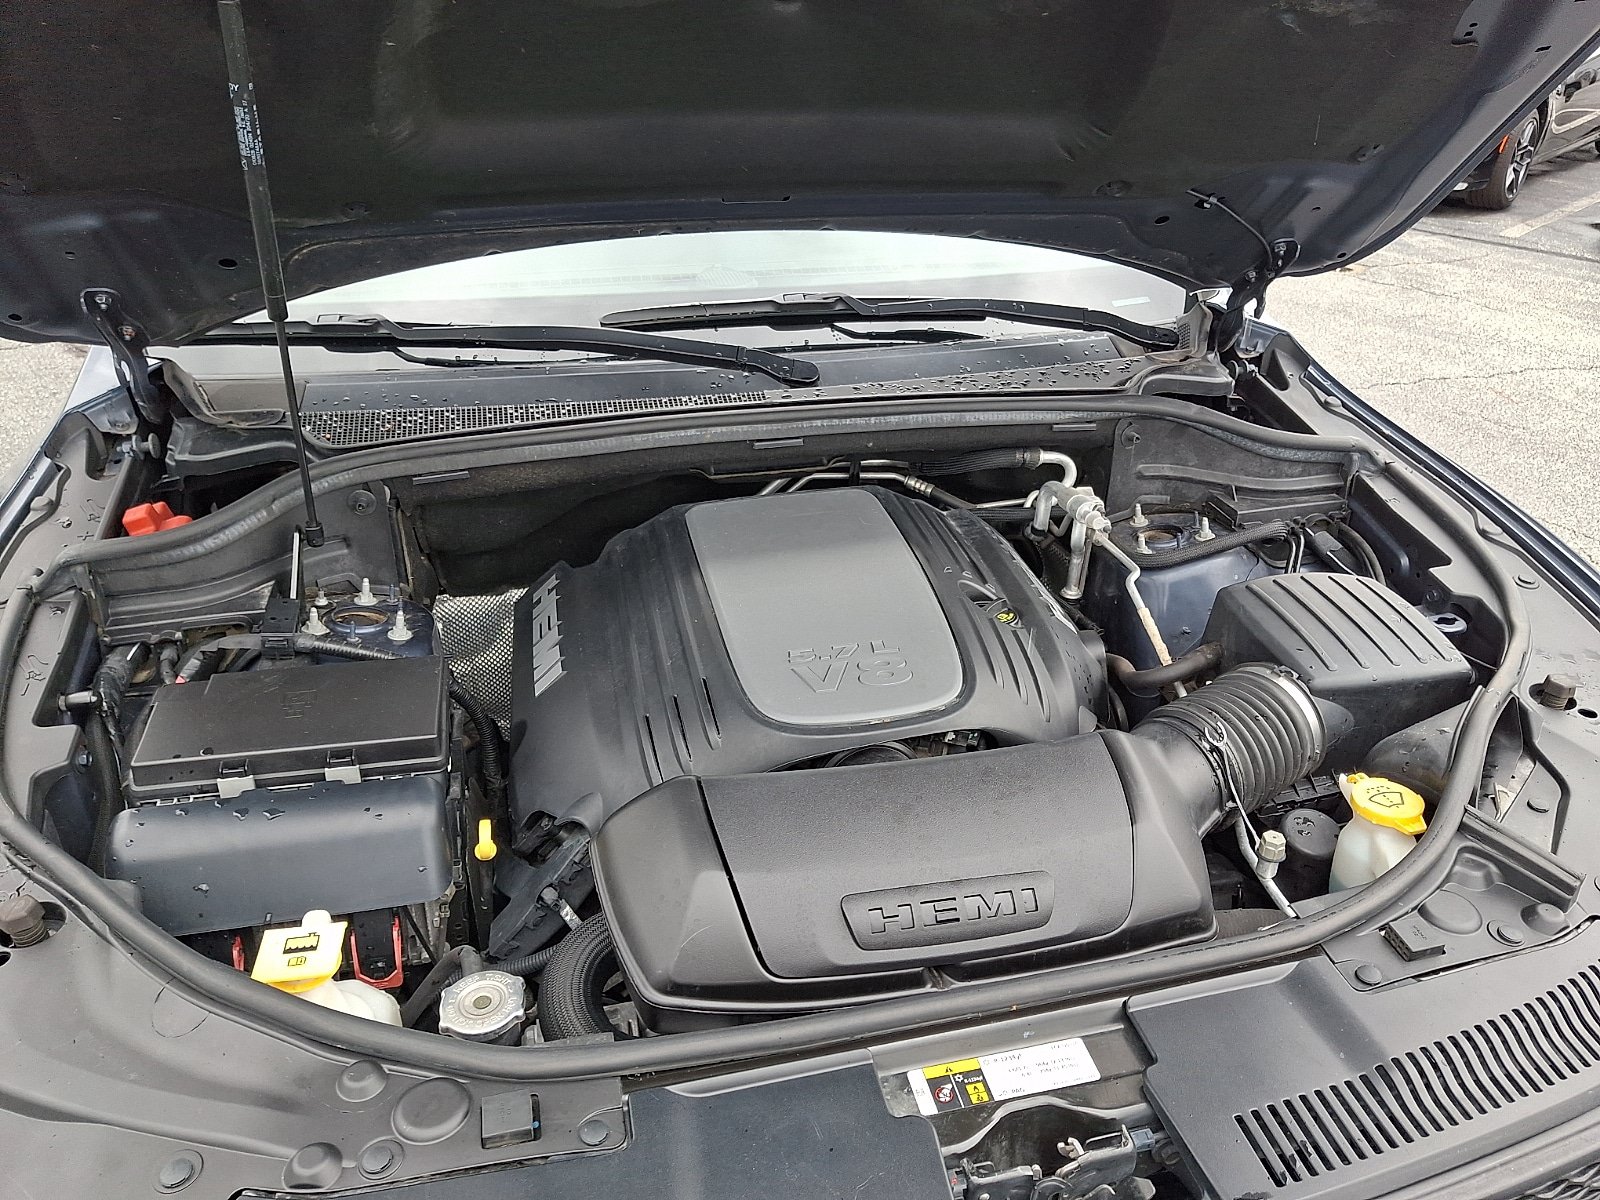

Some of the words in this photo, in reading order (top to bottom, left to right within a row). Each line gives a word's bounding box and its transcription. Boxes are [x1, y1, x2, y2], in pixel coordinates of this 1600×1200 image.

[532, 573, 568, 698] HEMI
[790, 657, 914, 693] V8
[867, 887, 1039, 935] HEMI
